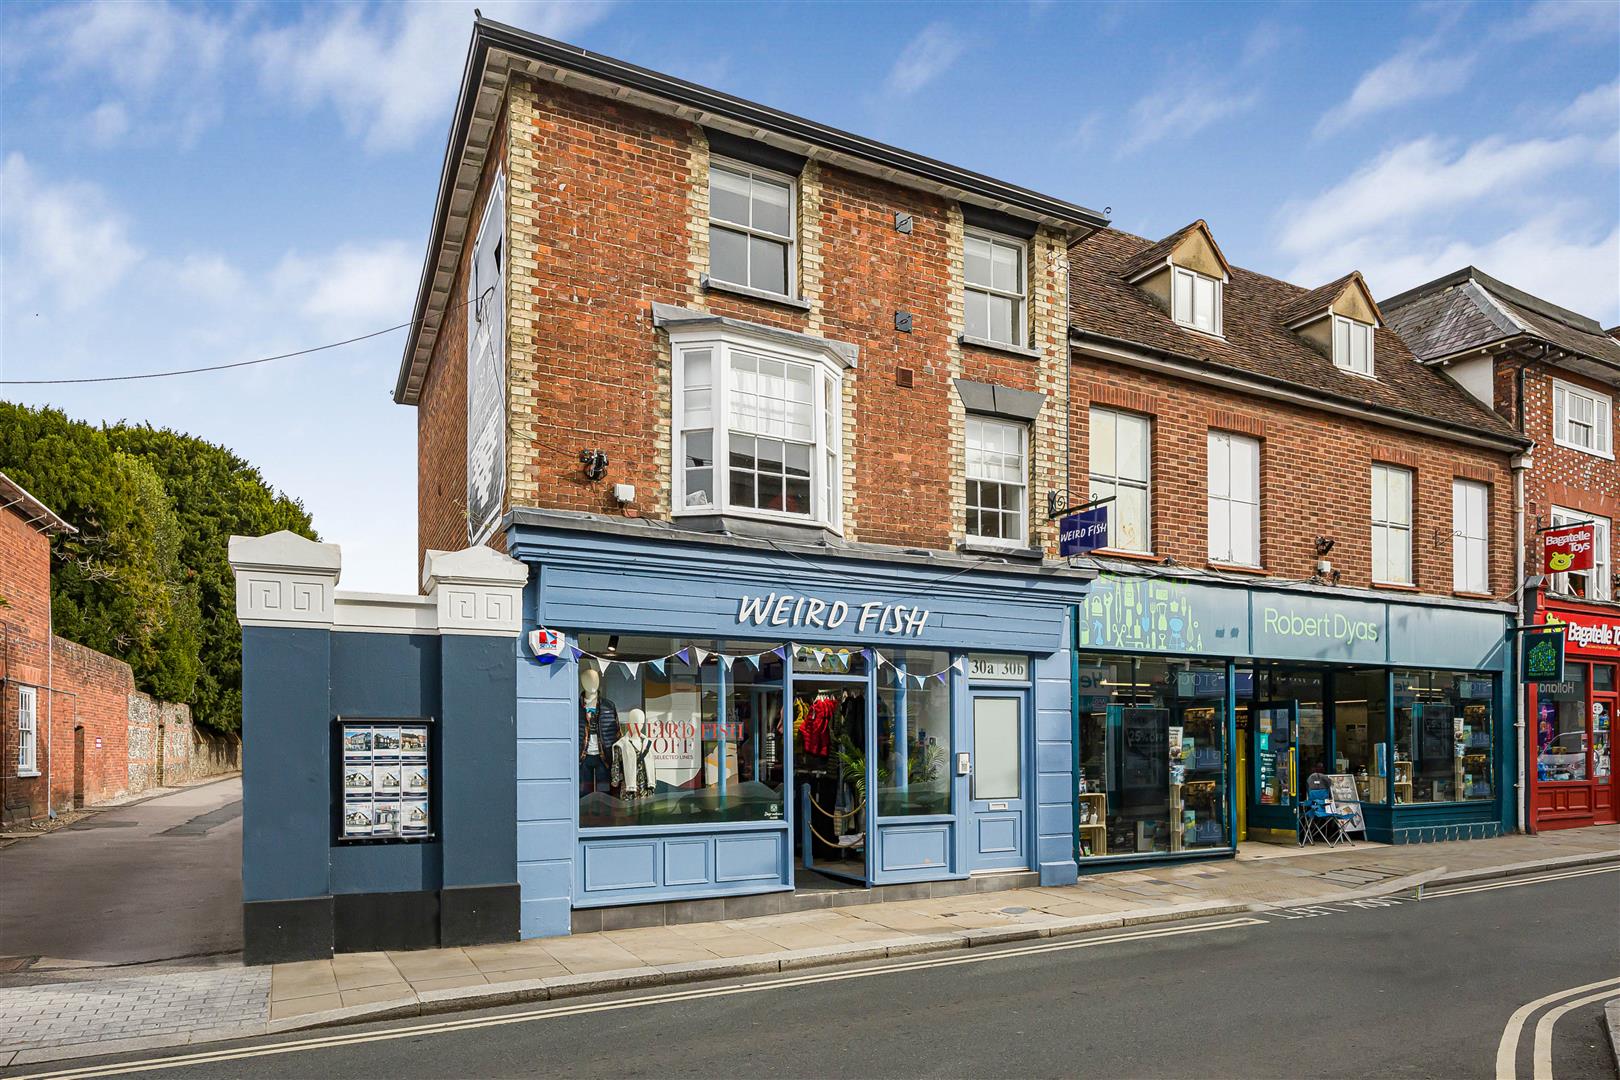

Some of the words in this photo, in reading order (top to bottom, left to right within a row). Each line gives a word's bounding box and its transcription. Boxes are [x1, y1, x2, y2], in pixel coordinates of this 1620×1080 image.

[1061, 528, 1086, 542] WEIRD
[1088, 523, 1107, 536] FISH
[1546, 531, 1590, 546] Bagatelle
[1569, 543, 1590, 553] Toys
[738, 592, 848, 629] WEIRD
[858, 602, 929, 636] FISH
[1264, 608, 1330, 638] Robert
[1334, 614, 1378, 645] Dyas
[1567, 622, 1612, 648] Bagatelle
[971, 660, 994, 674] 30a
[1002, 662, 1024, 675] 30b
[623, 722, 695, 739] WEIRD
[701, 723, 744, 740] FISH
[653, 737, 694, 753] OFF
